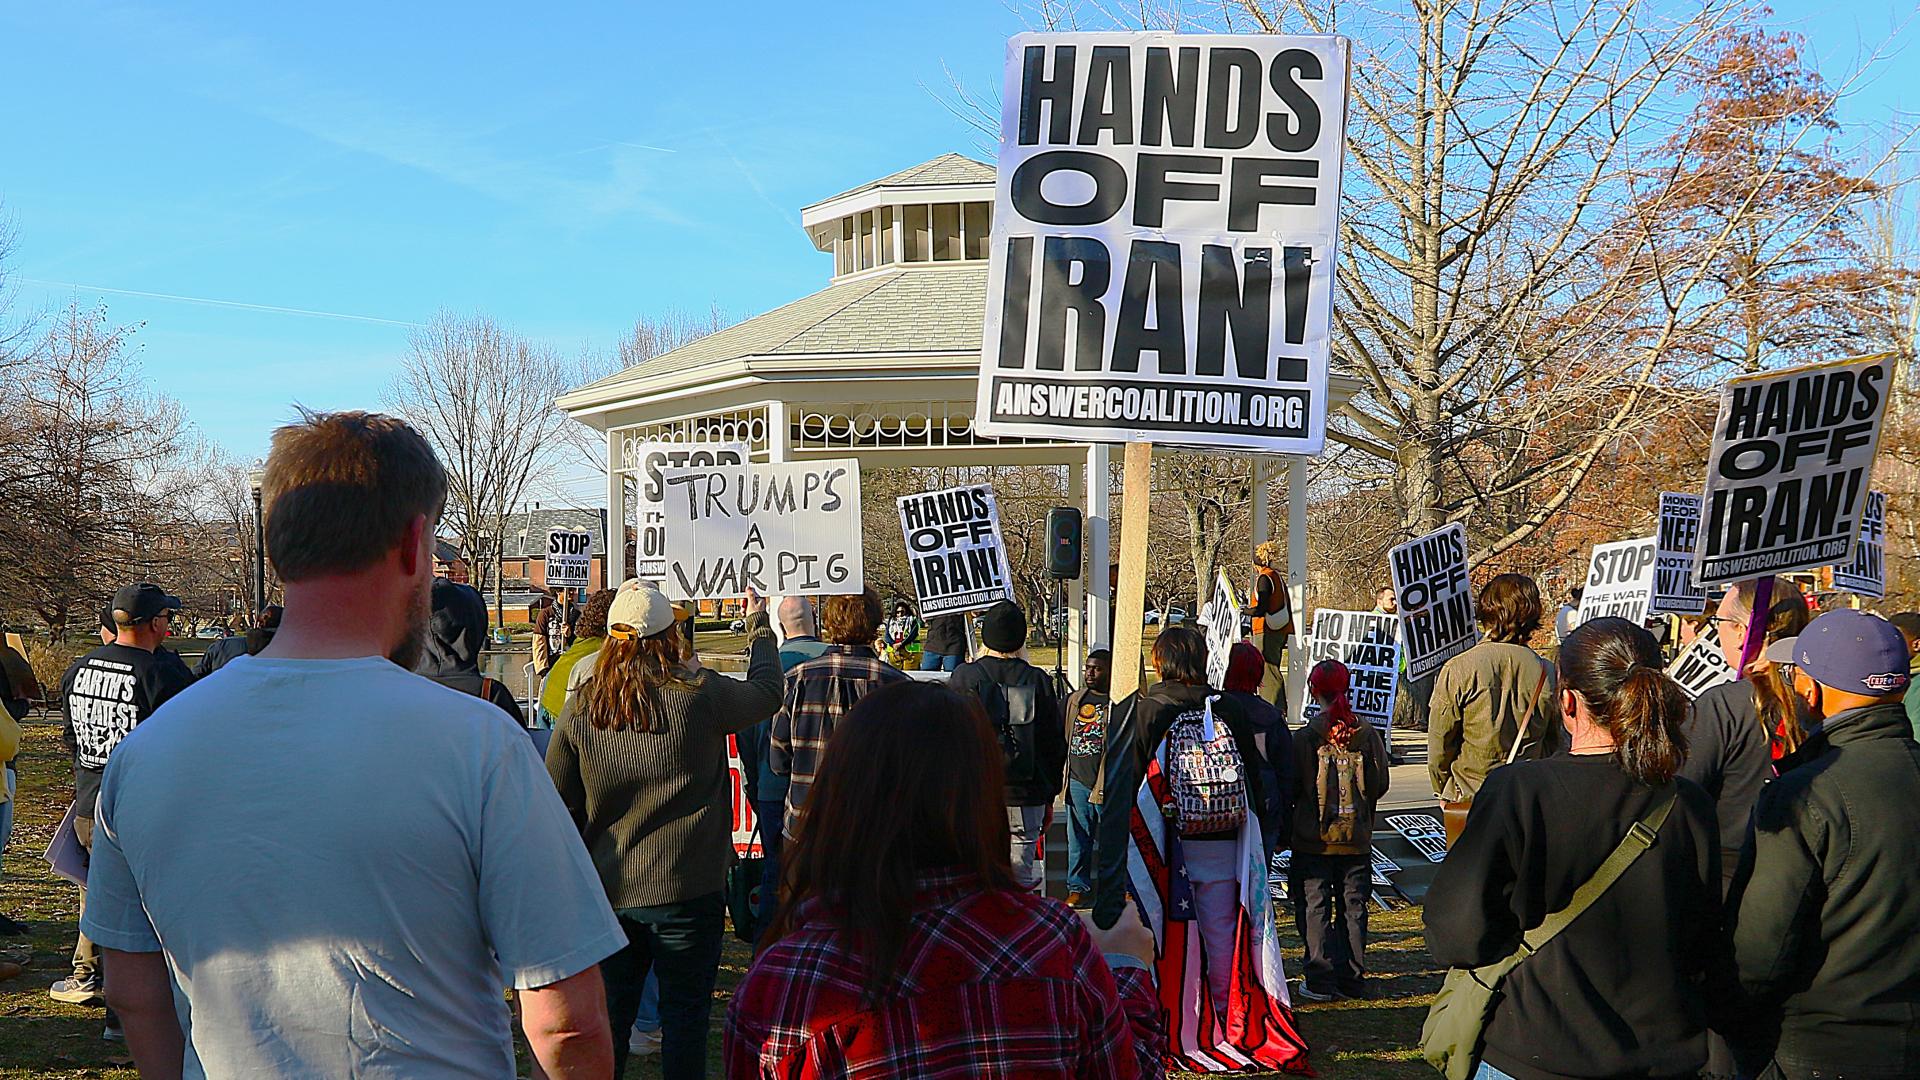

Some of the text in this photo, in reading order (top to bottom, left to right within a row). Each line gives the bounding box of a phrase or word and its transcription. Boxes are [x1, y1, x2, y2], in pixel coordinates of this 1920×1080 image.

[1018, 46, 1323, 152] HANDS
[1011, 150, 1319, 232] OFF
[998, 236, 1312, 382] IRAN!
[996, 382, 1303, 429] ANSWERCOALITION.ORG
[1725, 365, 1883, 440] HANDS
[1719, 421, 1873, 480] OFF
[667, 468, 846, 520] TRUMP'S
[903, 488, 988, 530] HANDS
[1663, 496, 1699, 506] MONEY
[1705, 467, 1864, 556] IRAN!
[549, 533, 590, 555] STOP
[743, 523, 765, 550] A
[910, 520, 992, 552] OFF
[1660, 517, 1699, 553] NEE
[548, 565, 588, 578] ON IRAN
[672, 551, 849, 597] WAR PIG
[913, 547, 1003, 598] IRAN!
[1394, 528, 1463, 587] HANDS
[1590, 544, 1656, 587] STOP
[1657, 557, 1685, 568] NOT
[1704, 539, 1847, 579] ANSWERCOALITION.ORG
[922, 590, 1005, 611] ANSWERCOALITION.ORG
[1401, 563, 1466, 612] OFF
[1585, 589, 1648, 604] THE WAR
[1315, 613, 1398, 646] NO NEW
[1404, 591, 1473, 660] IRAN!
[1313, 642, 1395, 668] US WAR
[73, 667, 136, 702] EARTH'S
[1356, 690, 1391, 713] EAST
[69, 694, 139, 730] GREATEST
